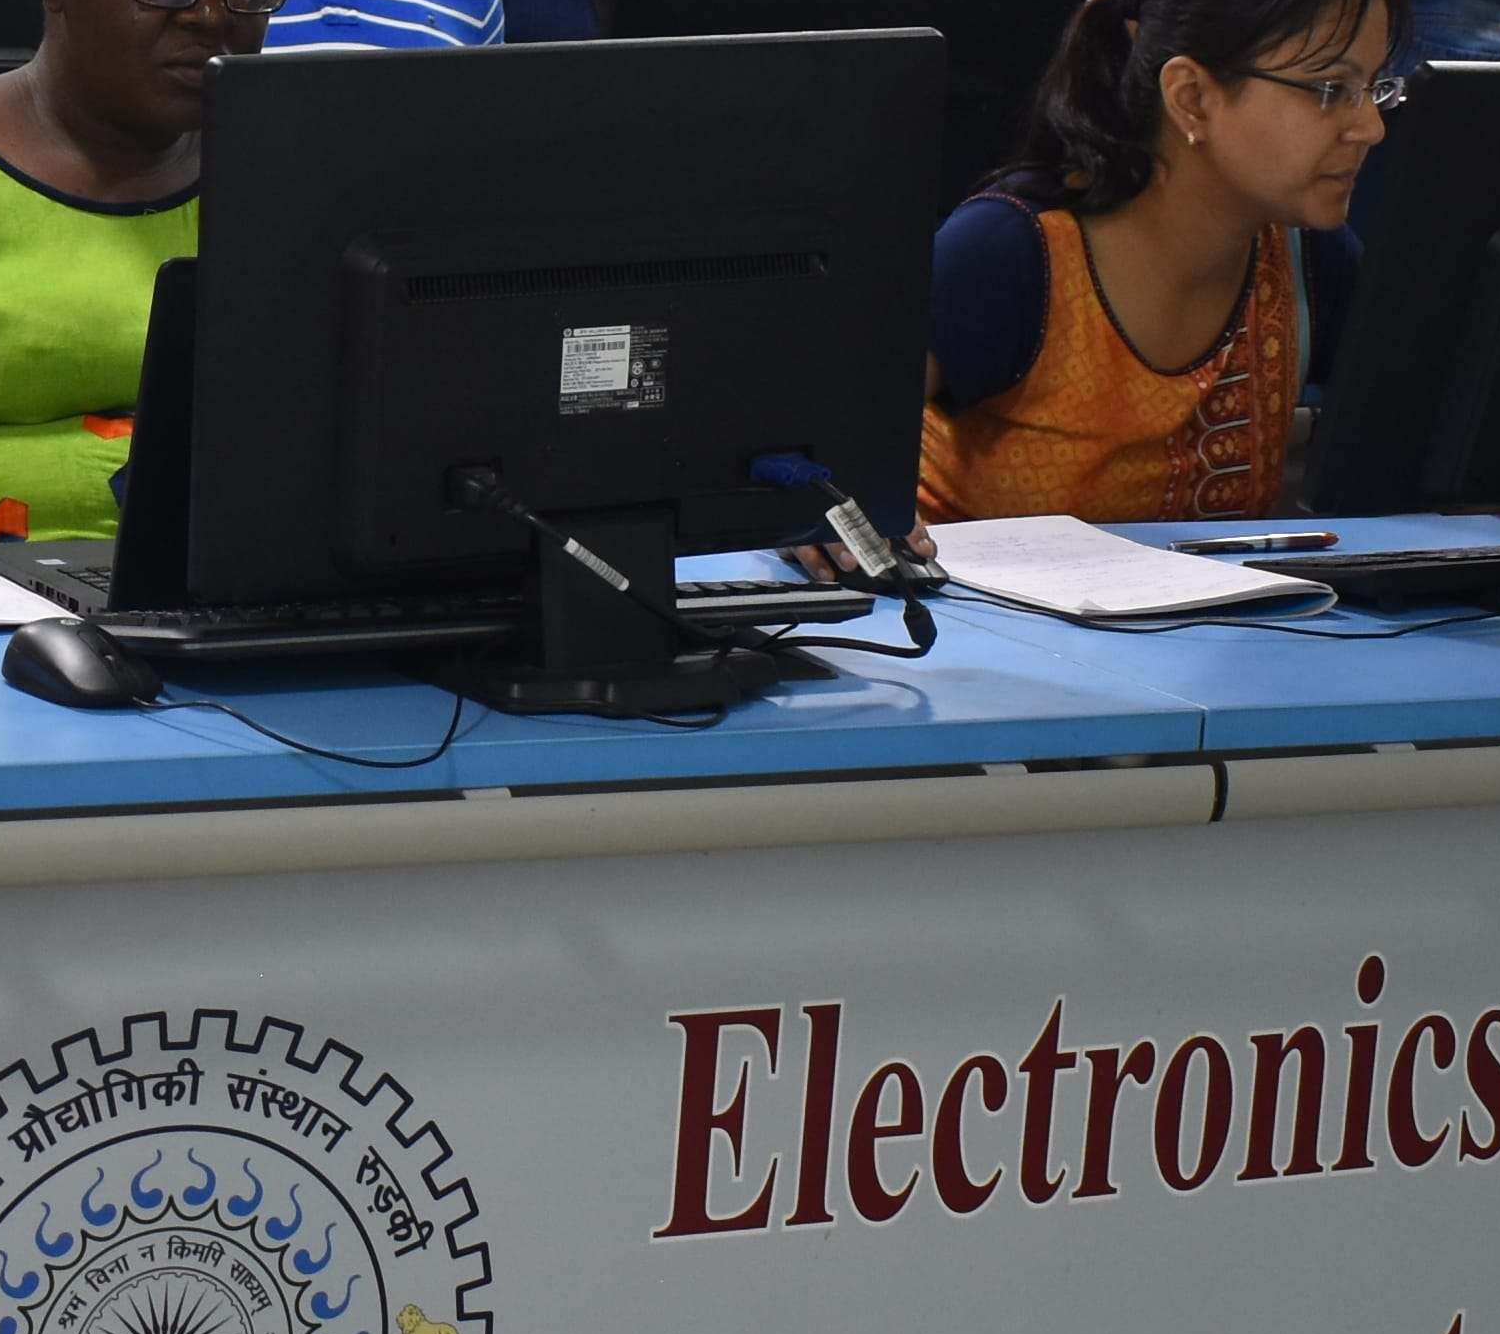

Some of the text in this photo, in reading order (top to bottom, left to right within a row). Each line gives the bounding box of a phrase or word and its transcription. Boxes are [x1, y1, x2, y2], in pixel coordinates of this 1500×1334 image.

[8, 1058, 203, 1162] प्रौद्योगिकी
[226, 1069, 353, 1153] संस्थान
[355, 1145, 434, 1258] रुड़की
[85, 1254, 130, 1292] विना
[138, 1244, 155, 1262] न
[167, 1235, 226, 1268] किमपि
